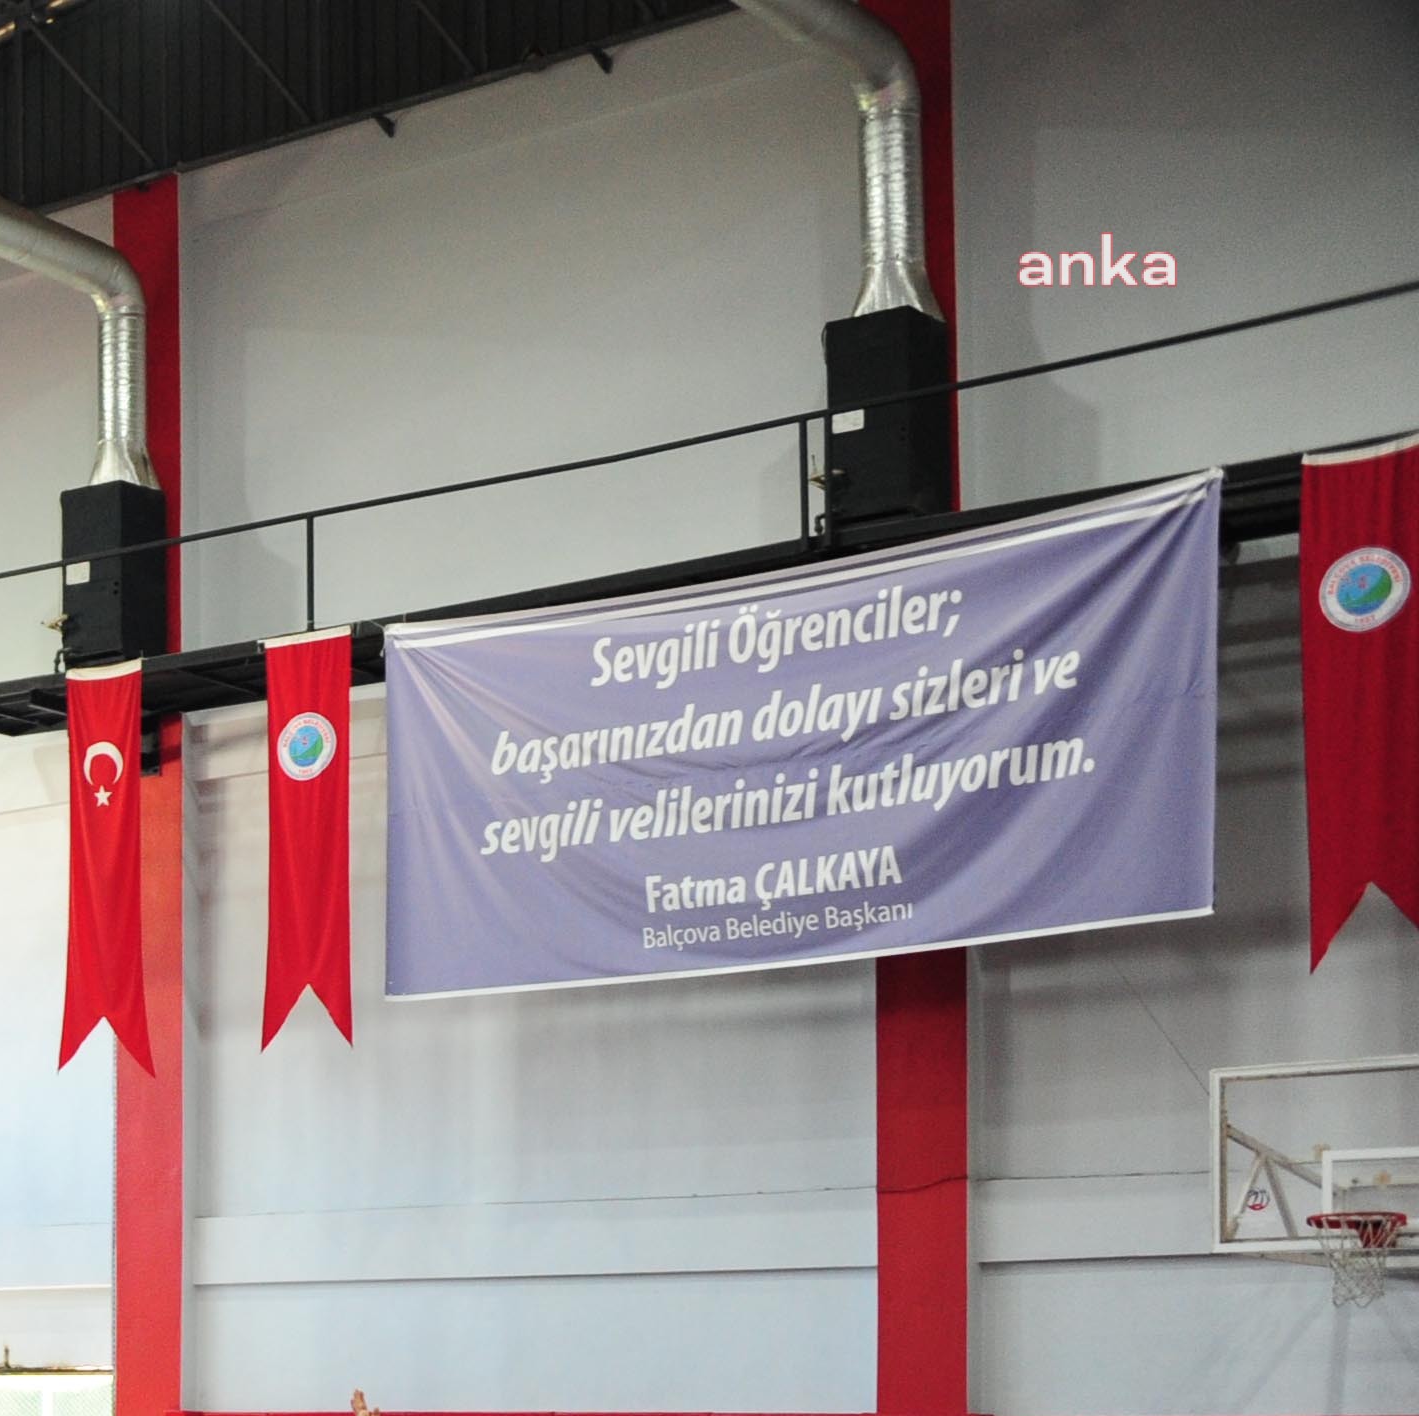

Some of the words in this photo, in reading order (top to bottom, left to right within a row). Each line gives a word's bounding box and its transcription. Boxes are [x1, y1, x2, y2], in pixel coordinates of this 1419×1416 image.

[590, 619, 721, 689] Sevgili
[728, 585, 963, 673] Öğrenciler;
[490, 703, 744, 784] başarınızdan
[752, 683, 883, 742] dolayı
[889, 648, 1024, 721] sizleri
[1033, 650, 1080, 695] ve
[480, 798, 603, 863] sevgili
[608, 767, 819, 842] velilerinizi
[826, 737, 1095, 816] kutluyorum.
[643, 925, 720, 951] Balçova
[726, 911, 819, 938] Belediye
[825, 901, 913, 931] Başkanı
[645, 874, 746, 913] Fatma
[755, 845, 902, 910] ÇALKAYA
